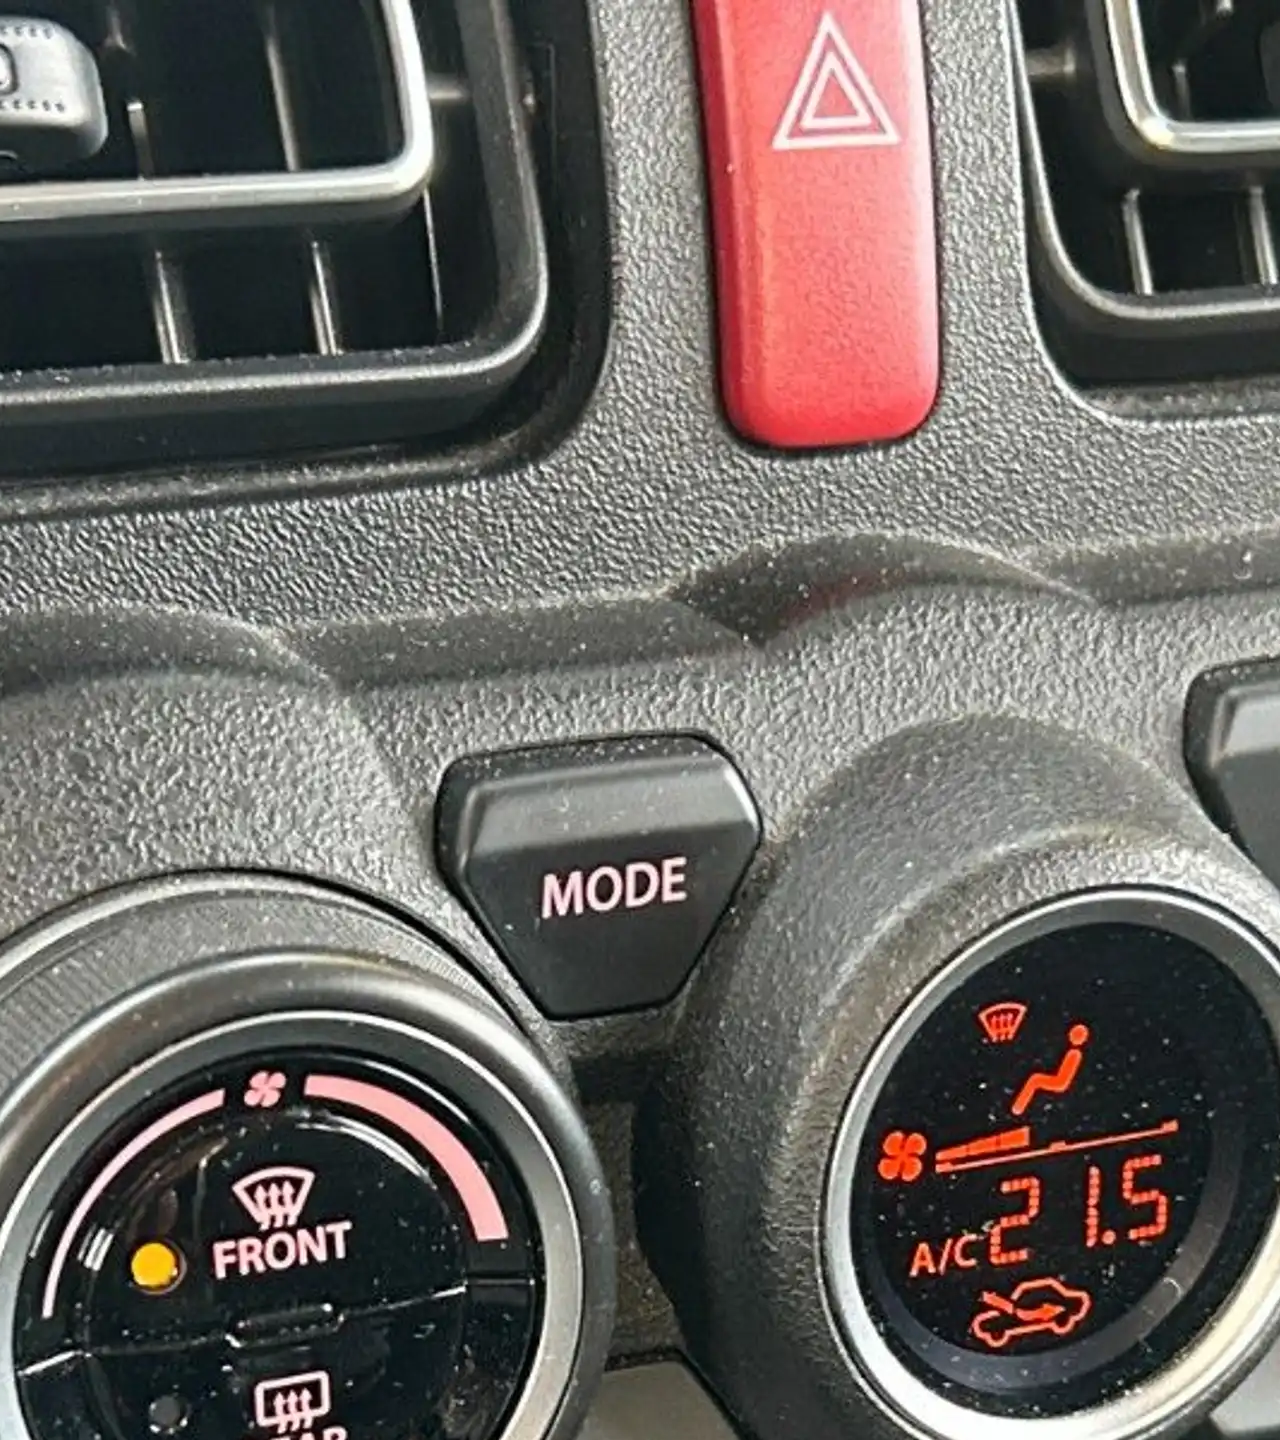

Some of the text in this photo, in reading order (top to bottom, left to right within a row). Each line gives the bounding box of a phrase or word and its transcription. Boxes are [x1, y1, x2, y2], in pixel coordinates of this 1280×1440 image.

[541, 856, 688, 919] MODE
[989, 1153, 1169, 1265] 21.5
[211, 1220, 353, 1280] FRONT
[909, 1232, 978, 1278] A/C
